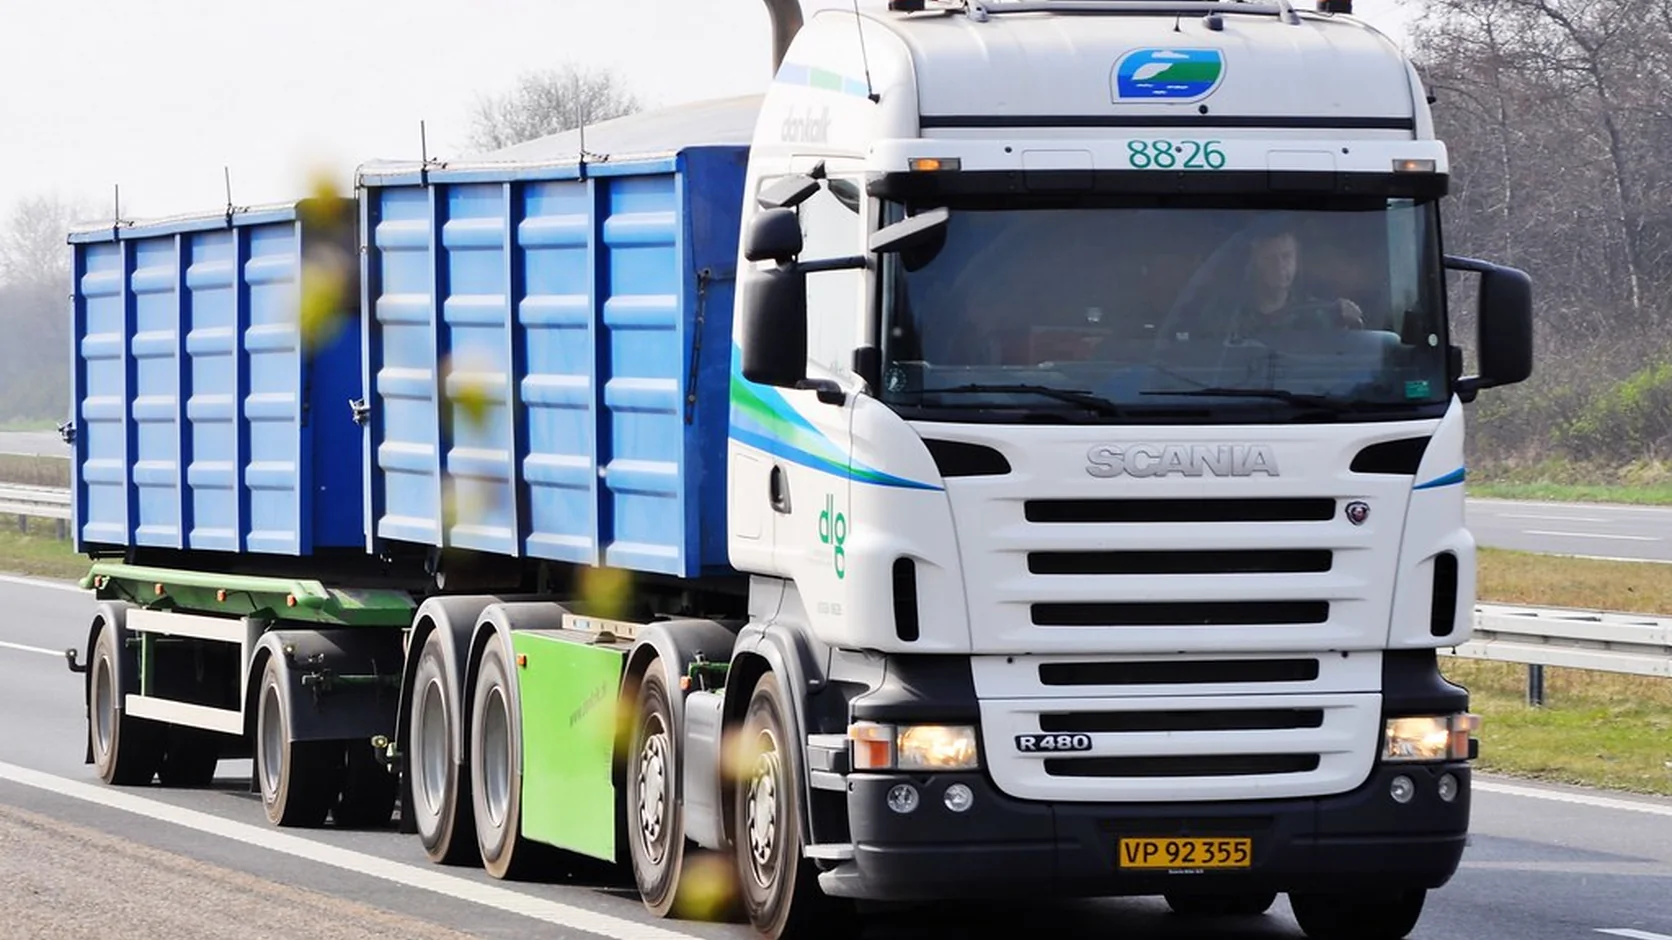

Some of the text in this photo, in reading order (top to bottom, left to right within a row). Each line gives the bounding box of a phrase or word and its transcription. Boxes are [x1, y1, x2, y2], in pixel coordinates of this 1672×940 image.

[1085, 443, 1280, 478] SCANIA
[819, 494, 846, 579] dlg
[1020, 735, 1089, 750] R 480
[1125, 841, 1248, 863] VP 92 355
